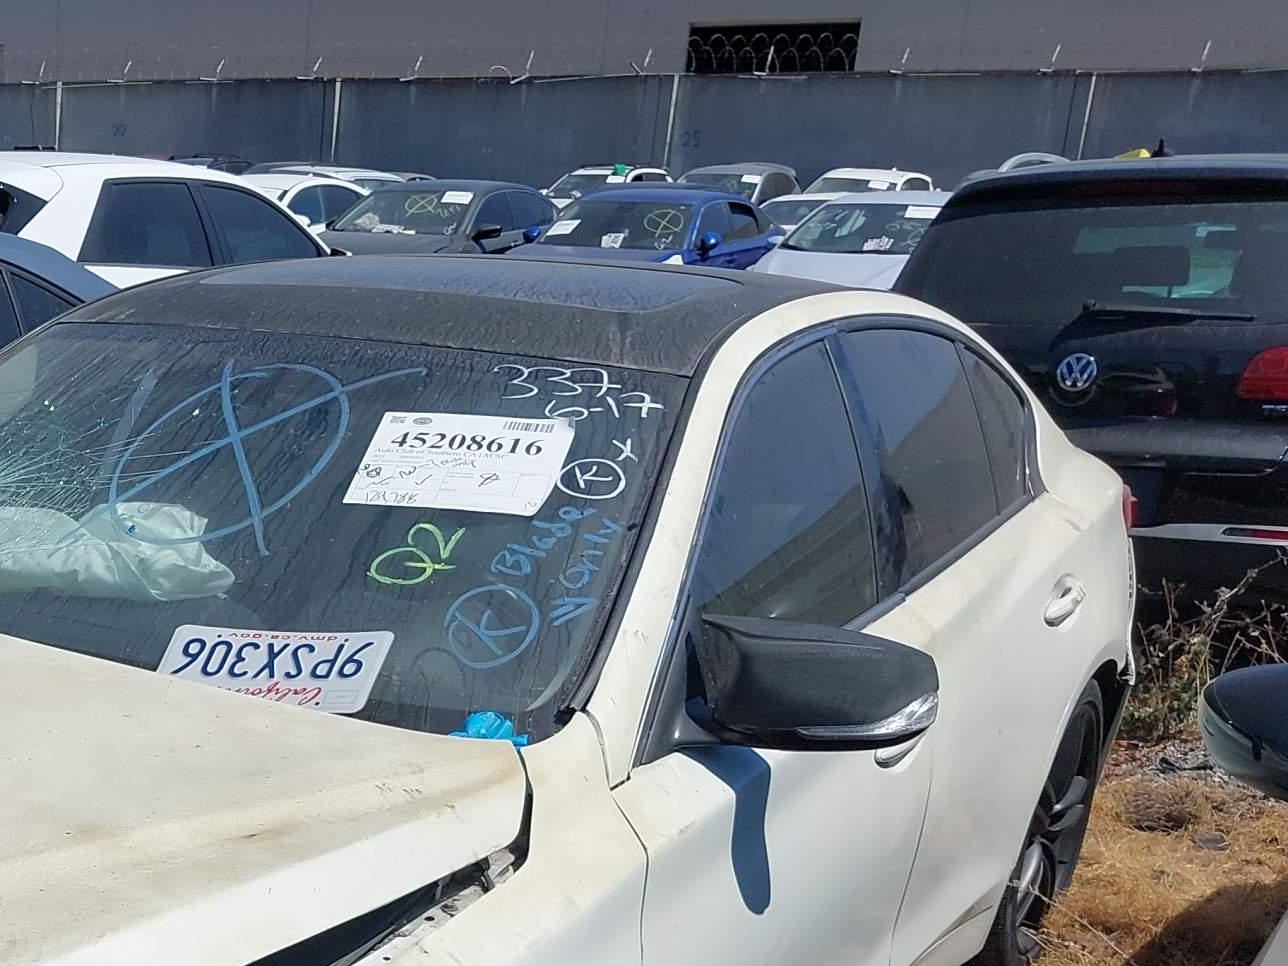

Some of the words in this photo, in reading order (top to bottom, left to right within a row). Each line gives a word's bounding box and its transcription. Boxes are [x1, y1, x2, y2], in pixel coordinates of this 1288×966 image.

[493, 364, 622, 399] 337
[391, 431, 546, 457] 45208616
[395, 448, 415, 456] Club
[228, 632, 338, 642] dmv.ca.gov
[169, 637, 376, 680] 9PSX306
